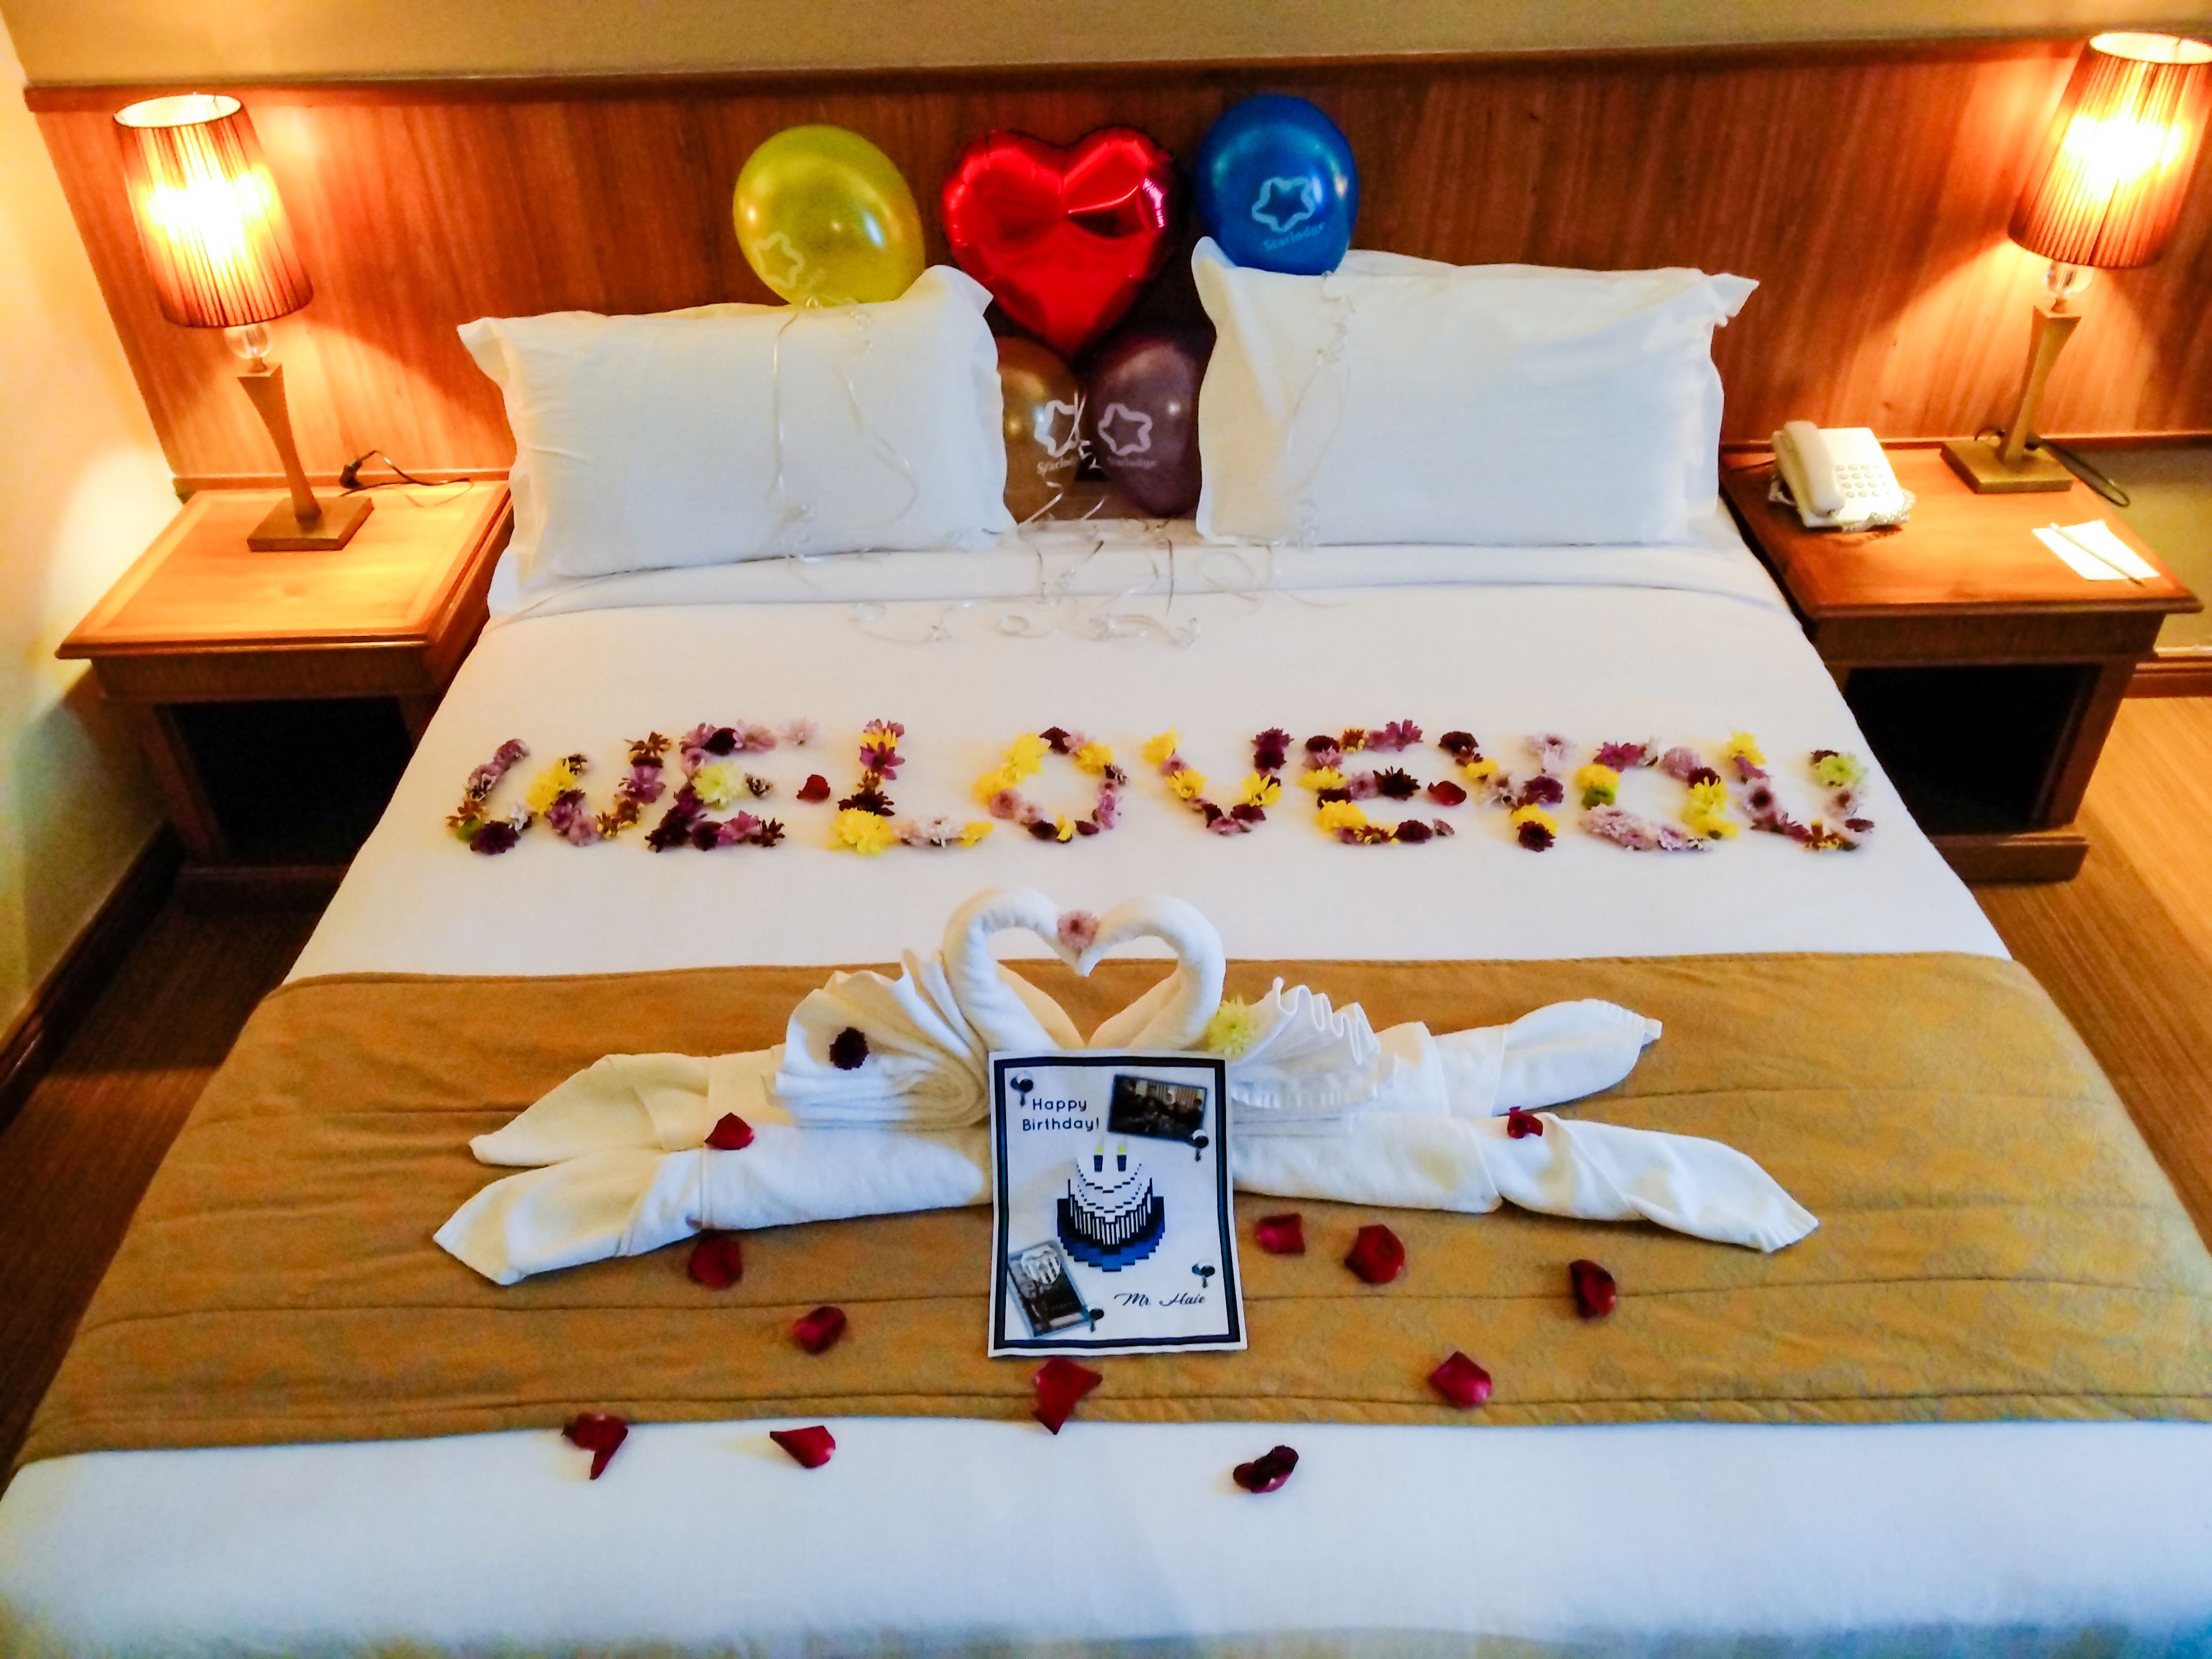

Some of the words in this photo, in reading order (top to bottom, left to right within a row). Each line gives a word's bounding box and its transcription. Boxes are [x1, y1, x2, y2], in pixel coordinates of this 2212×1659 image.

[447, 718, 817, 855] WE
[826, 718, 1455, 857] LOVE
[1438, 730, 1874, 853] YOU
[1032, 1098, 1086, 1112] Happy
[1022, 1117, 1099, 1132] Birthday!
